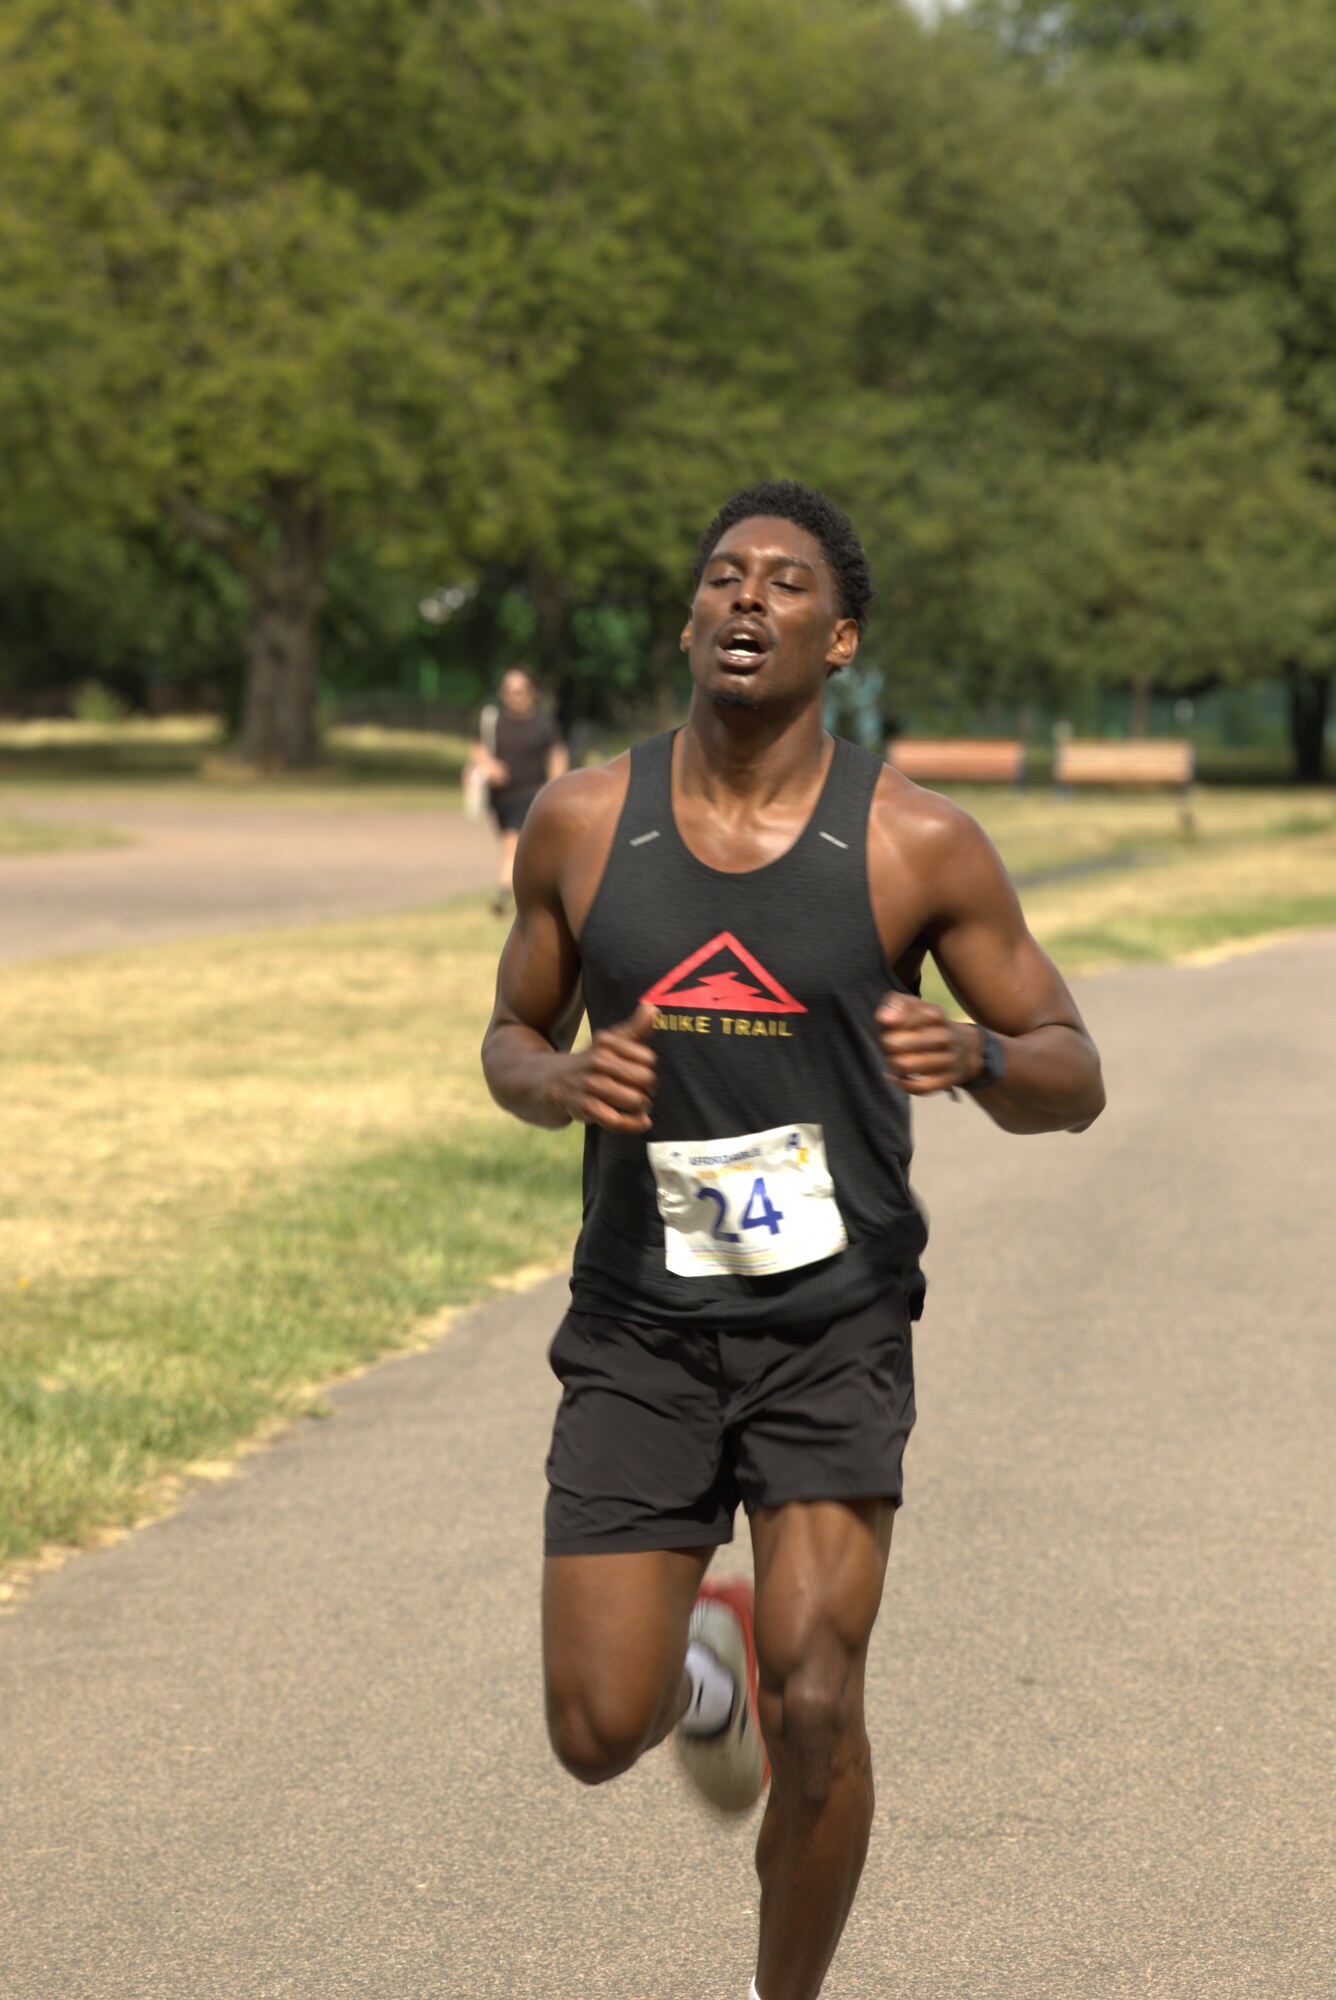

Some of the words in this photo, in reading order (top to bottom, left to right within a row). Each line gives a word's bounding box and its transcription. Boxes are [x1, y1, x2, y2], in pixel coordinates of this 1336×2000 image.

[652, 1013, 711, 1033] NIKE
[720, 1017, 793, 1036] TRAIL
[696, 1177, 783, 1243] 24
